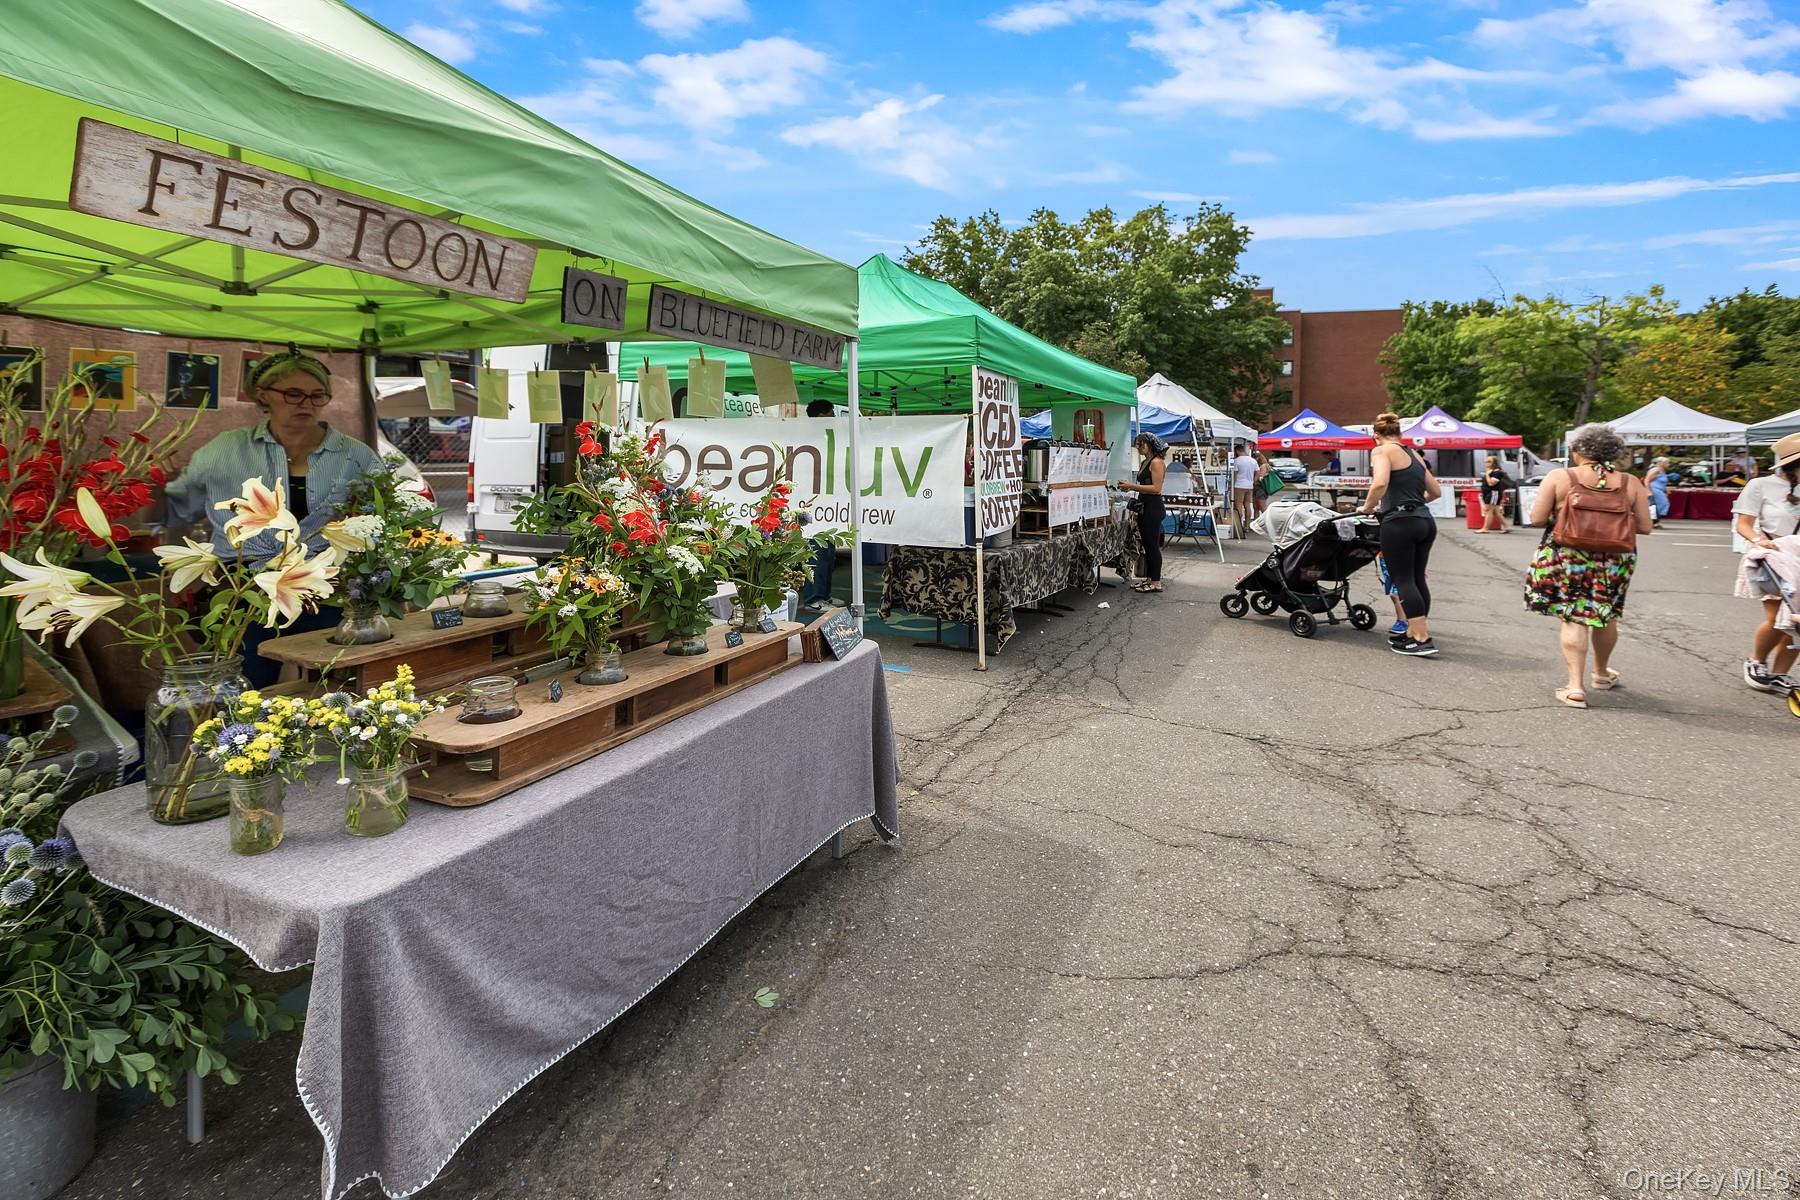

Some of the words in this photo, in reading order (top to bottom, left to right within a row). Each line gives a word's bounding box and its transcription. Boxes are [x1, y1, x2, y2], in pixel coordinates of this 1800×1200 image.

[137, 148, 511, 291] FESTOON
[572, 279, 624, 323] ON
[659, 292, 785, 351] BLUEFIELD
[792, 328, 842, 364] FARM
